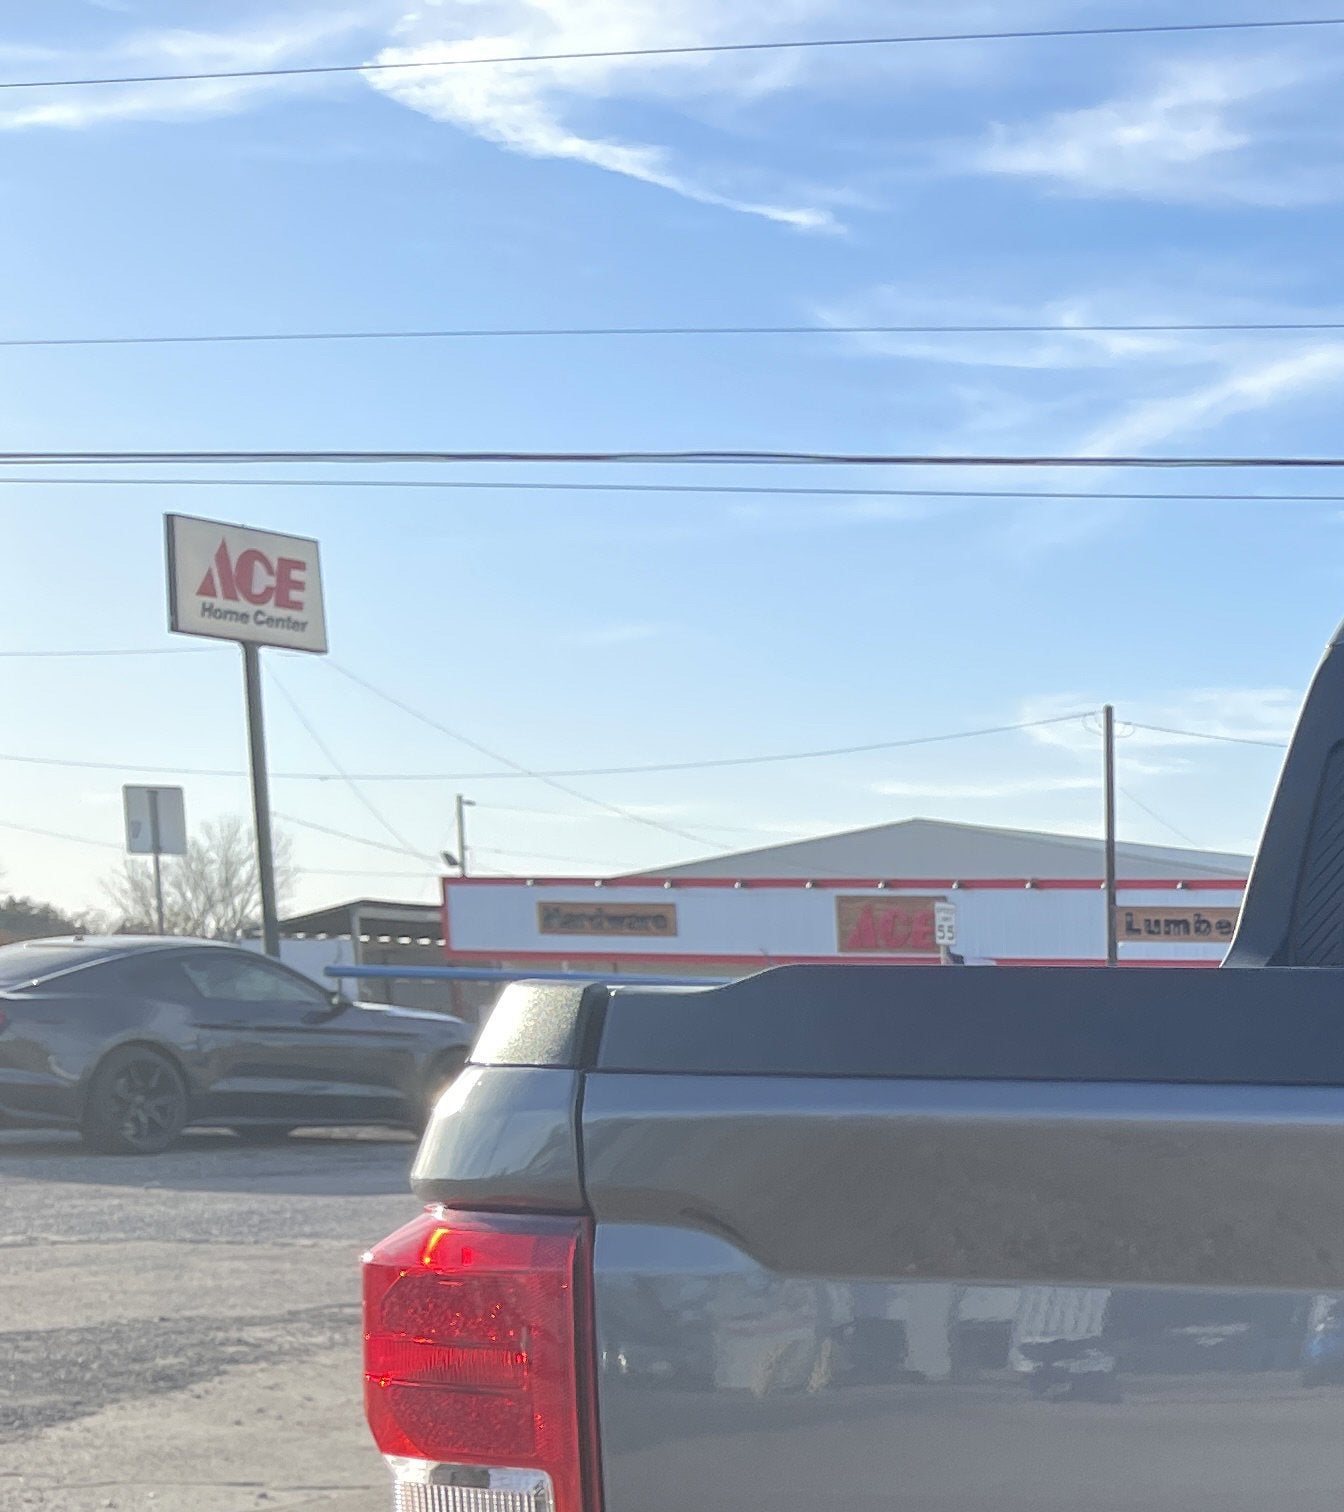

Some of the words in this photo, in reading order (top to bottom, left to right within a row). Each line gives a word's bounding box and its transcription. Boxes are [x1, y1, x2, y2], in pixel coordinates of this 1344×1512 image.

[196, 537, 306, 611] ACE
[201, 602, 249, 625] Home
[253, 609, 308, 632] Center
[847, 903, 936, 950] ACE
[1125, 912, 1233, 936] Lumbe
